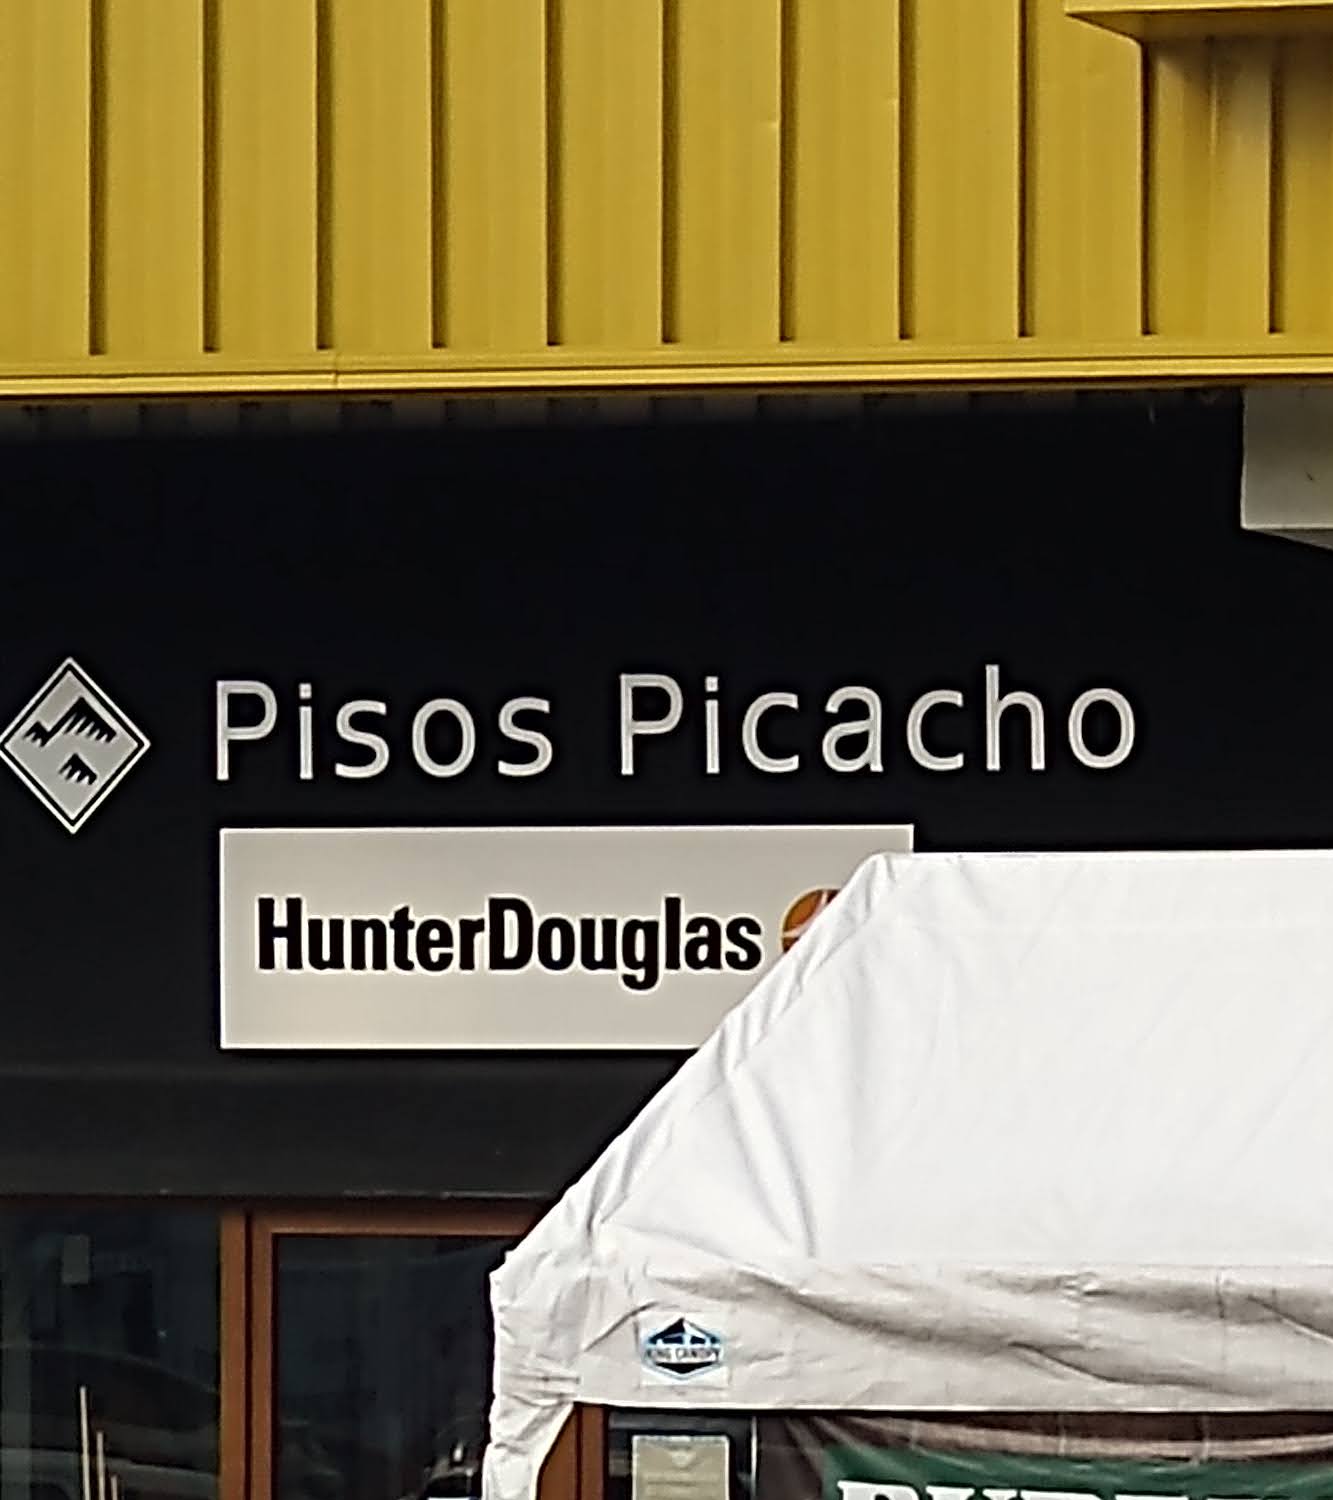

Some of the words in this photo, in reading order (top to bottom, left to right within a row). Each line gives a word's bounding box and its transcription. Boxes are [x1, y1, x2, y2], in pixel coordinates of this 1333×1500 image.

[215, 679, 554, 781] Pisos
[618, 664, 1136, 776] Picacho
[257, 896, 763, 991] HunterDouglas
